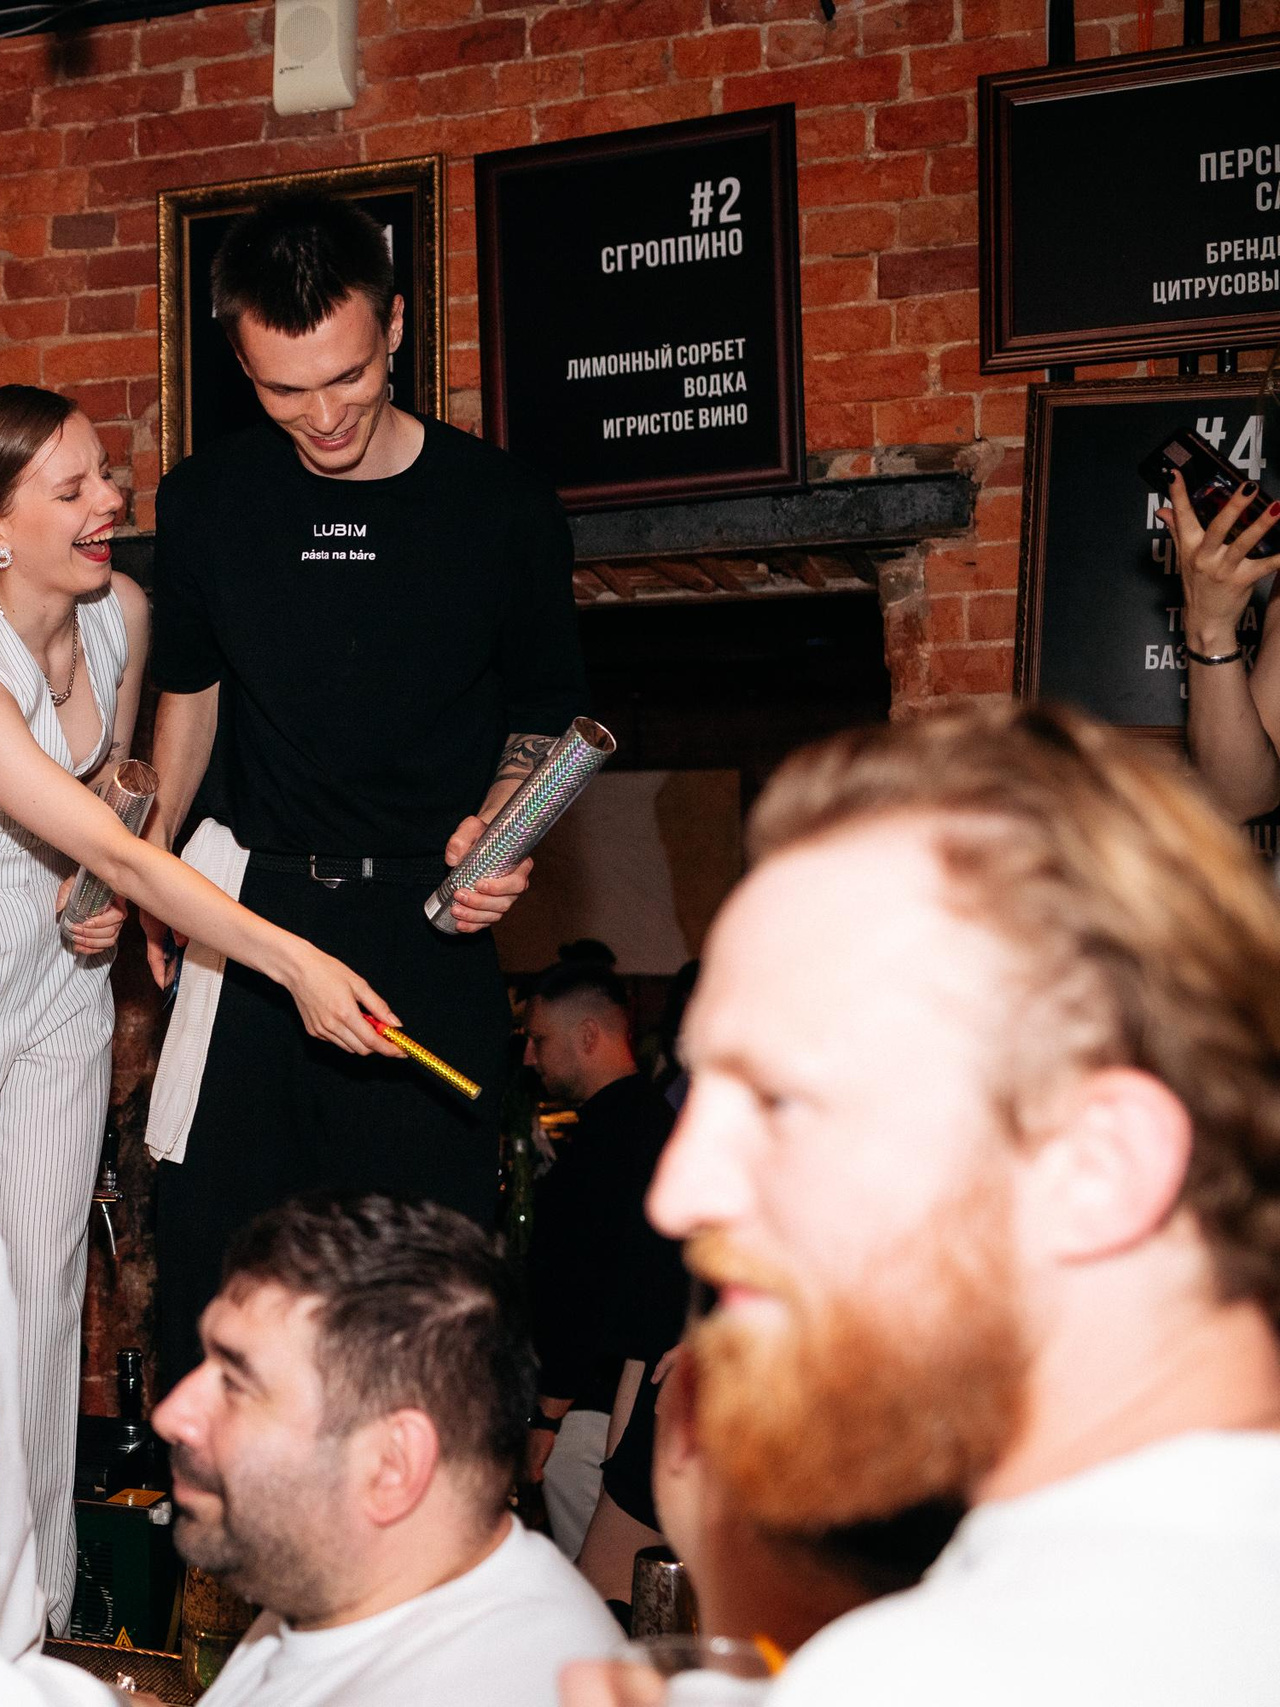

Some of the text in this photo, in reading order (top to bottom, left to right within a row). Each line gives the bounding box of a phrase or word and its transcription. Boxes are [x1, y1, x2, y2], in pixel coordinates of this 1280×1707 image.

[689, 176, 742, 228] #2
[600, 227, 744, 274] СГРОППИНО
[565, 336, 747, 381] ЛИМОННЫЙ СОРБЕТ
[682, 369, 748, 399] ВОДКА
[602, 402, 749, 440] ИГРИСТОЕ ВИНО
[313, 523, 367, 538] LUBIM
[331, 551, 347, 560] na
